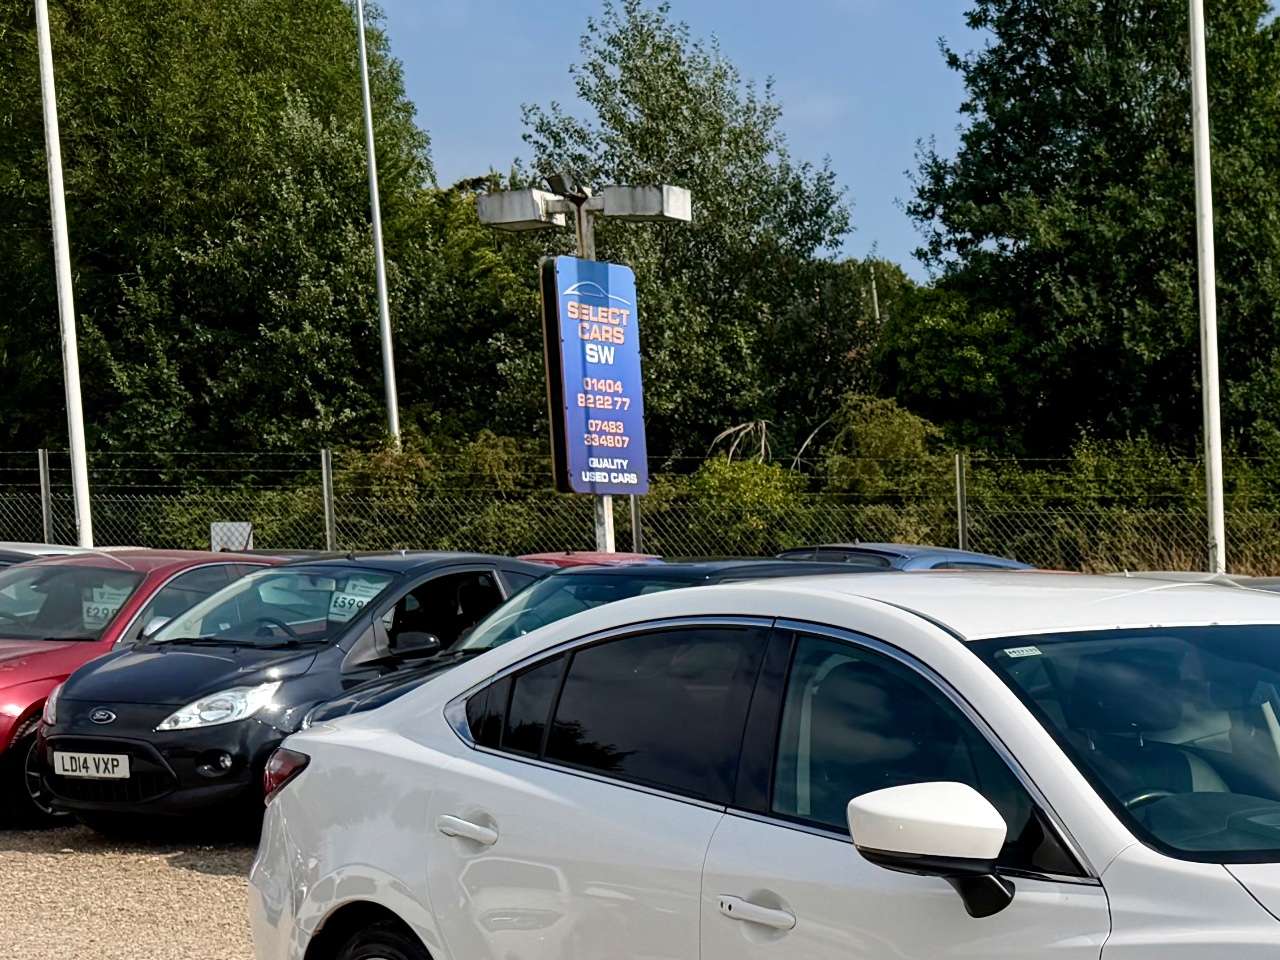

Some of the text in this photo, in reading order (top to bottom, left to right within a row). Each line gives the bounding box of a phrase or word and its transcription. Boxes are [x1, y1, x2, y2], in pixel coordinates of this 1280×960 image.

[567, 301, 630, 327] SELECT
[578, 321, 625, 345] CARS
[585, 343, 615, 365] SW
[583, 377, 623, 394] 01404
[583, 433, 630, 448] 334807
[588, 457, 629, 470] QUALITY
[581, 470, 638, 484] USED CARS
[61, 755, 120, 774] LD14 VXP
